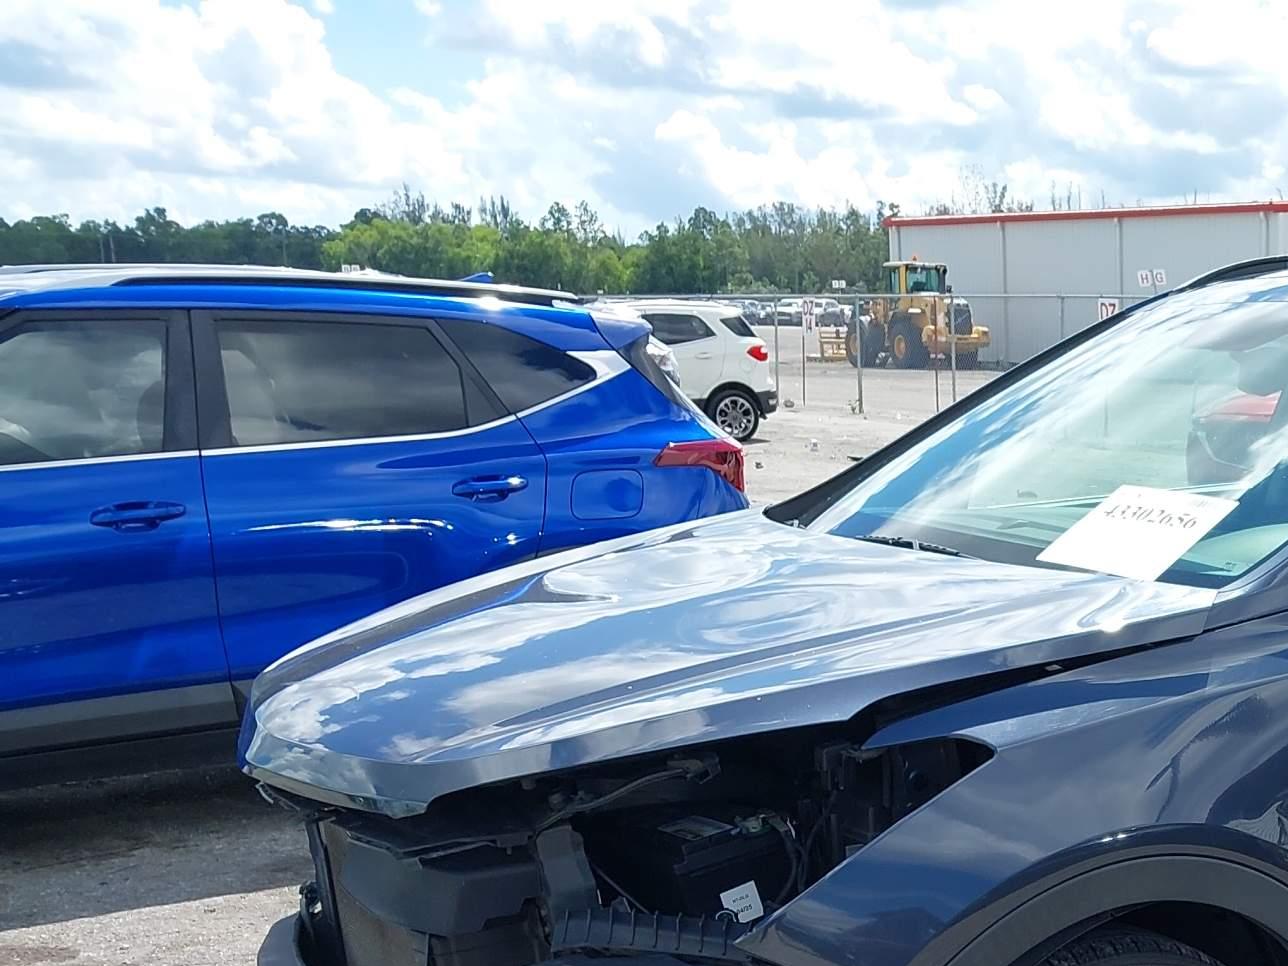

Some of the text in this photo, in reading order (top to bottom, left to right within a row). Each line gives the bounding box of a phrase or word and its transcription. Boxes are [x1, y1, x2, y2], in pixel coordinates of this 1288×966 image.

[1140, 271, 1164, 284] H G
[1103, 504, 1197, 529] 43302656
